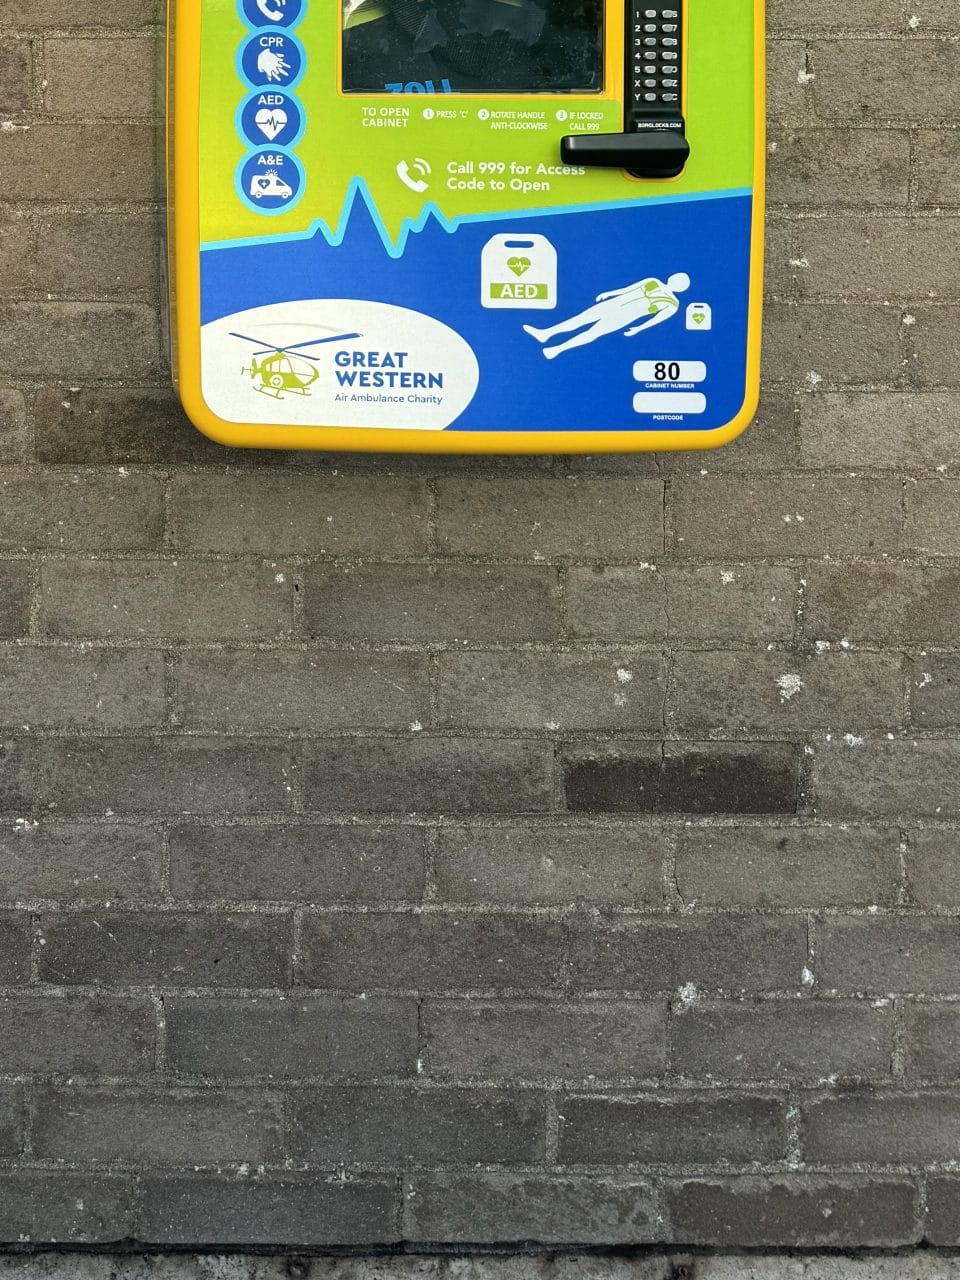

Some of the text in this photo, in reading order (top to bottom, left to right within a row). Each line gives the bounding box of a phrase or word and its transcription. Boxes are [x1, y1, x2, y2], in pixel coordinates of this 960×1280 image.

[634, 11, 641, 19] 1
[634, 25, 641, 33] 2
[260, 37, 283, 46] CPR
[634, 39, 641, 47] 3
[634, 52, 641, 60] 4
[634, 66, 641, 74] 5
[634, 80, 641, 88] X
[258, 95, 283, 105] AED
[634, 94, 641, 102] Y
[362, 107, 410, 117] TO OPEN
[436, 111, 457, 119] PRESS
[490, 111, 516, 119] ROTATE
[569, 112, 576, 120] IF
[577, 112, 604, 120] LOCKED
[362, 118, 409, 128] CABINET
[490, 122, 548, 130] ANTI-CLOCKWISE
[569, 123, 600, 131] CALL 999
[258, 155, 283, 165] A&E
[447, 161, 586, 175] Call 999 for Access
[447, 177, 550, 194] Code to Open
[500, 284, 538, 299] AED
[334, 350, 409, 368] GREAT
[654, 362, 680, 381] 80
[335, 370, 443, 389] WESTERN
[335, 393, 443, 405] Air Ambulance Charity
